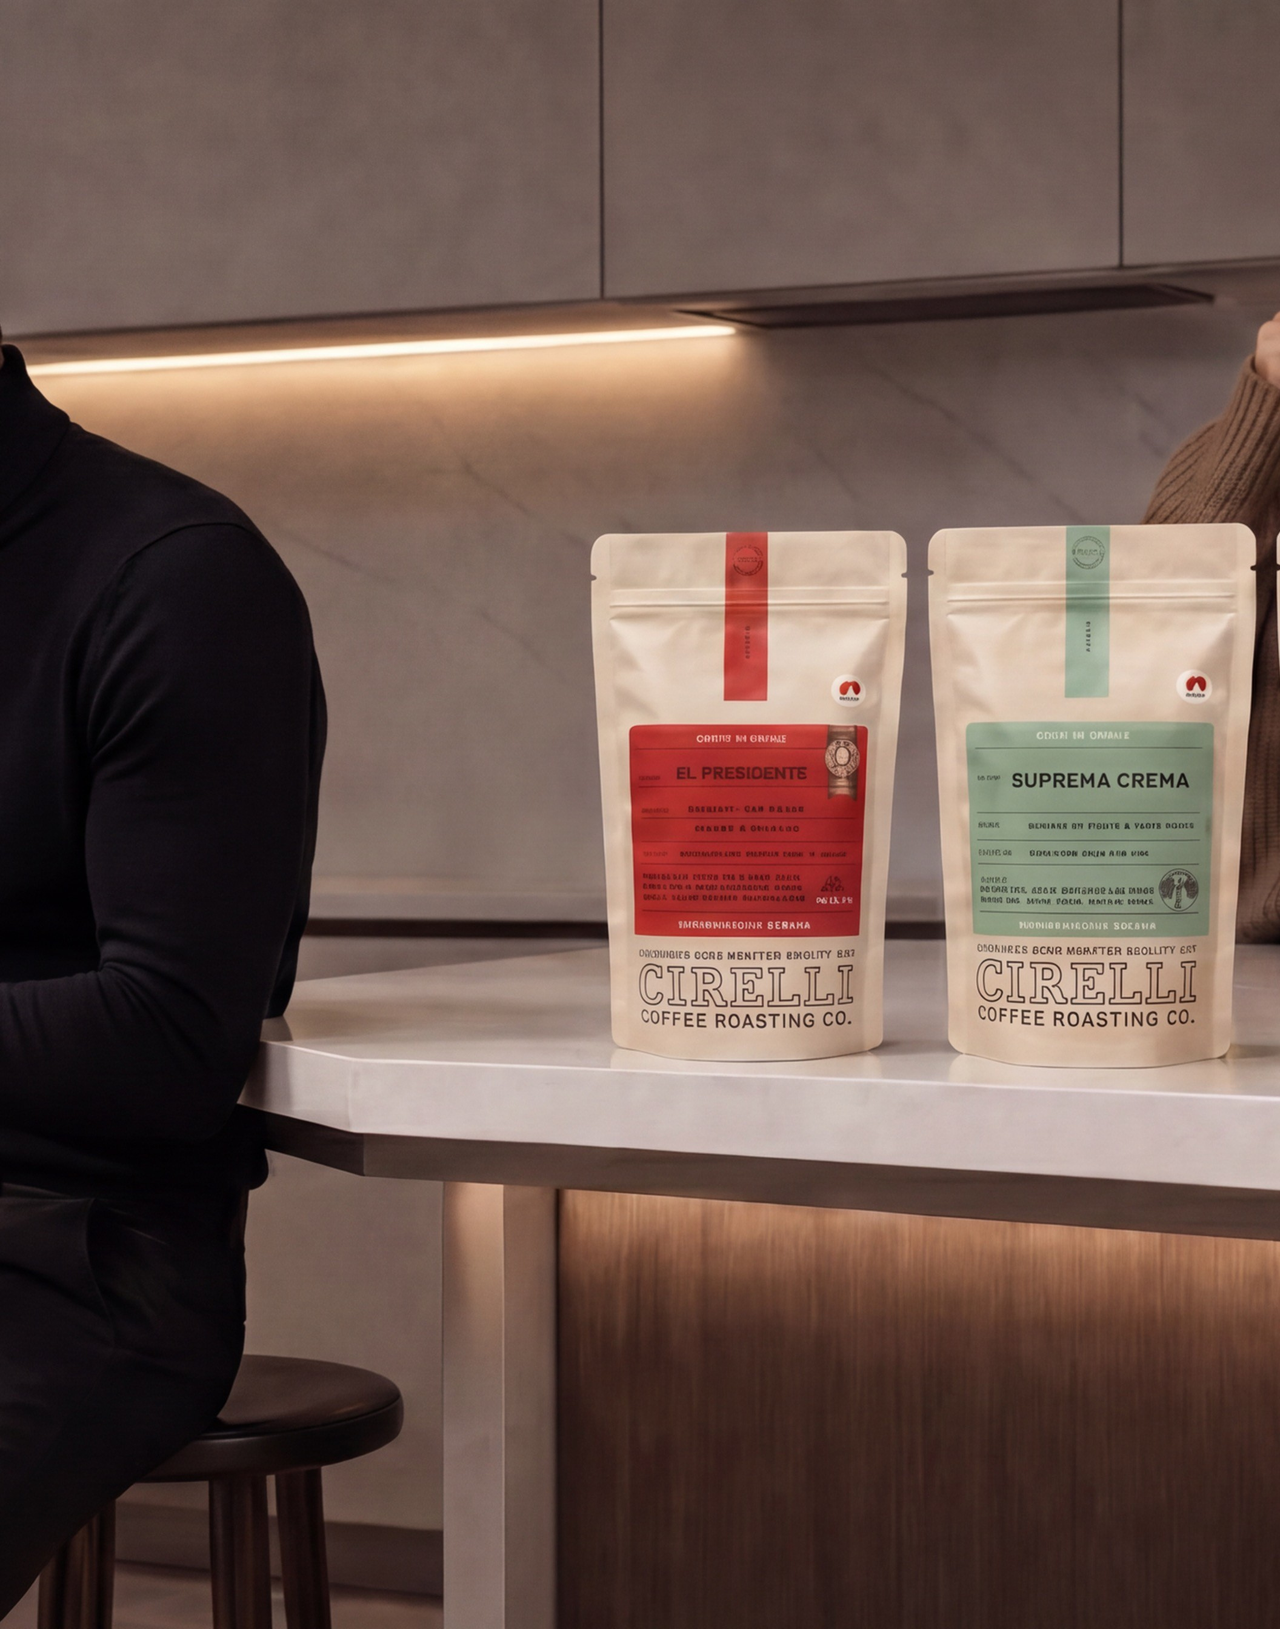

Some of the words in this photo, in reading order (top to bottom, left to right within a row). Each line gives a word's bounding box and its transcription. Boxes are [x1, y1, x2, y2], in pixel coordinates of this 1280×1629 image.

[676, 767, 697, 780] EL
[1012, 773, 1111, 788] SUPREMA
[1117, 773, 1190, 788] CREMA
[638, 963, 854, 1007] CIRELLI
[976, 958, 1197, 1005] CIRELLI
[641, 1009, 707, 1028] COFFEE
[715, 1012, 815, 1029] ROASTING
[822, 1011, 852, 1026] CO.
[978, 1005, 1045, 1027] COFFEE
[1053, 1010, 1158, 1027] ROASTING
[1166, 1009, 1195, 1025] CO.
